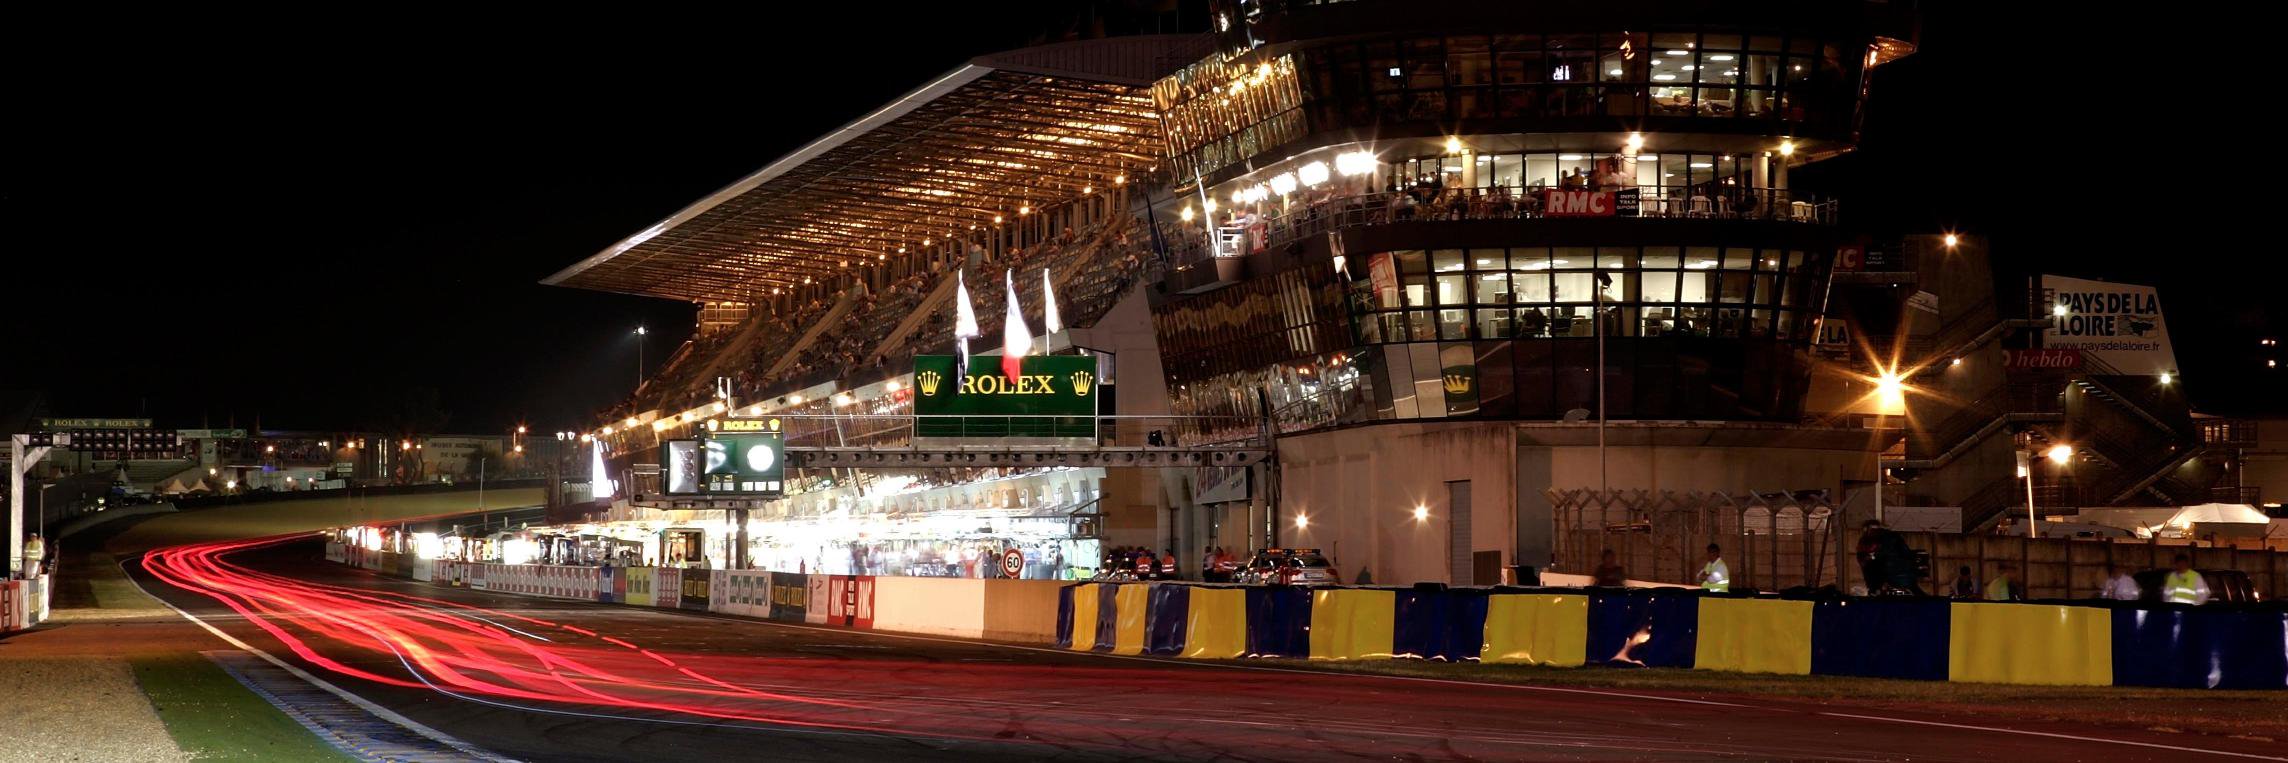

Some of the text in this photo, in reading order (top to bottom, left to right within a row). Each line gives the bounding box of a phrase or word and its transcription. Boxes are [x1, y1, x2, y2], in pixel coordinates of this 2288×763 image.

[1548, 191, 1606, 213] RMC
[2059, 293, 2158, 315] PAYS DE LA
[2059, 315, 2116, 336] LOIRE
[2016, 349, 2074, 368] hebdo
[959, 375, 1055, 395] ROLEX
[723, 420, 765, 431] ROLEX
[1007, 556, 1019, 568] 60
[831, 579, 844, 617] RMC
[857, 580, 871, 620] RMC
